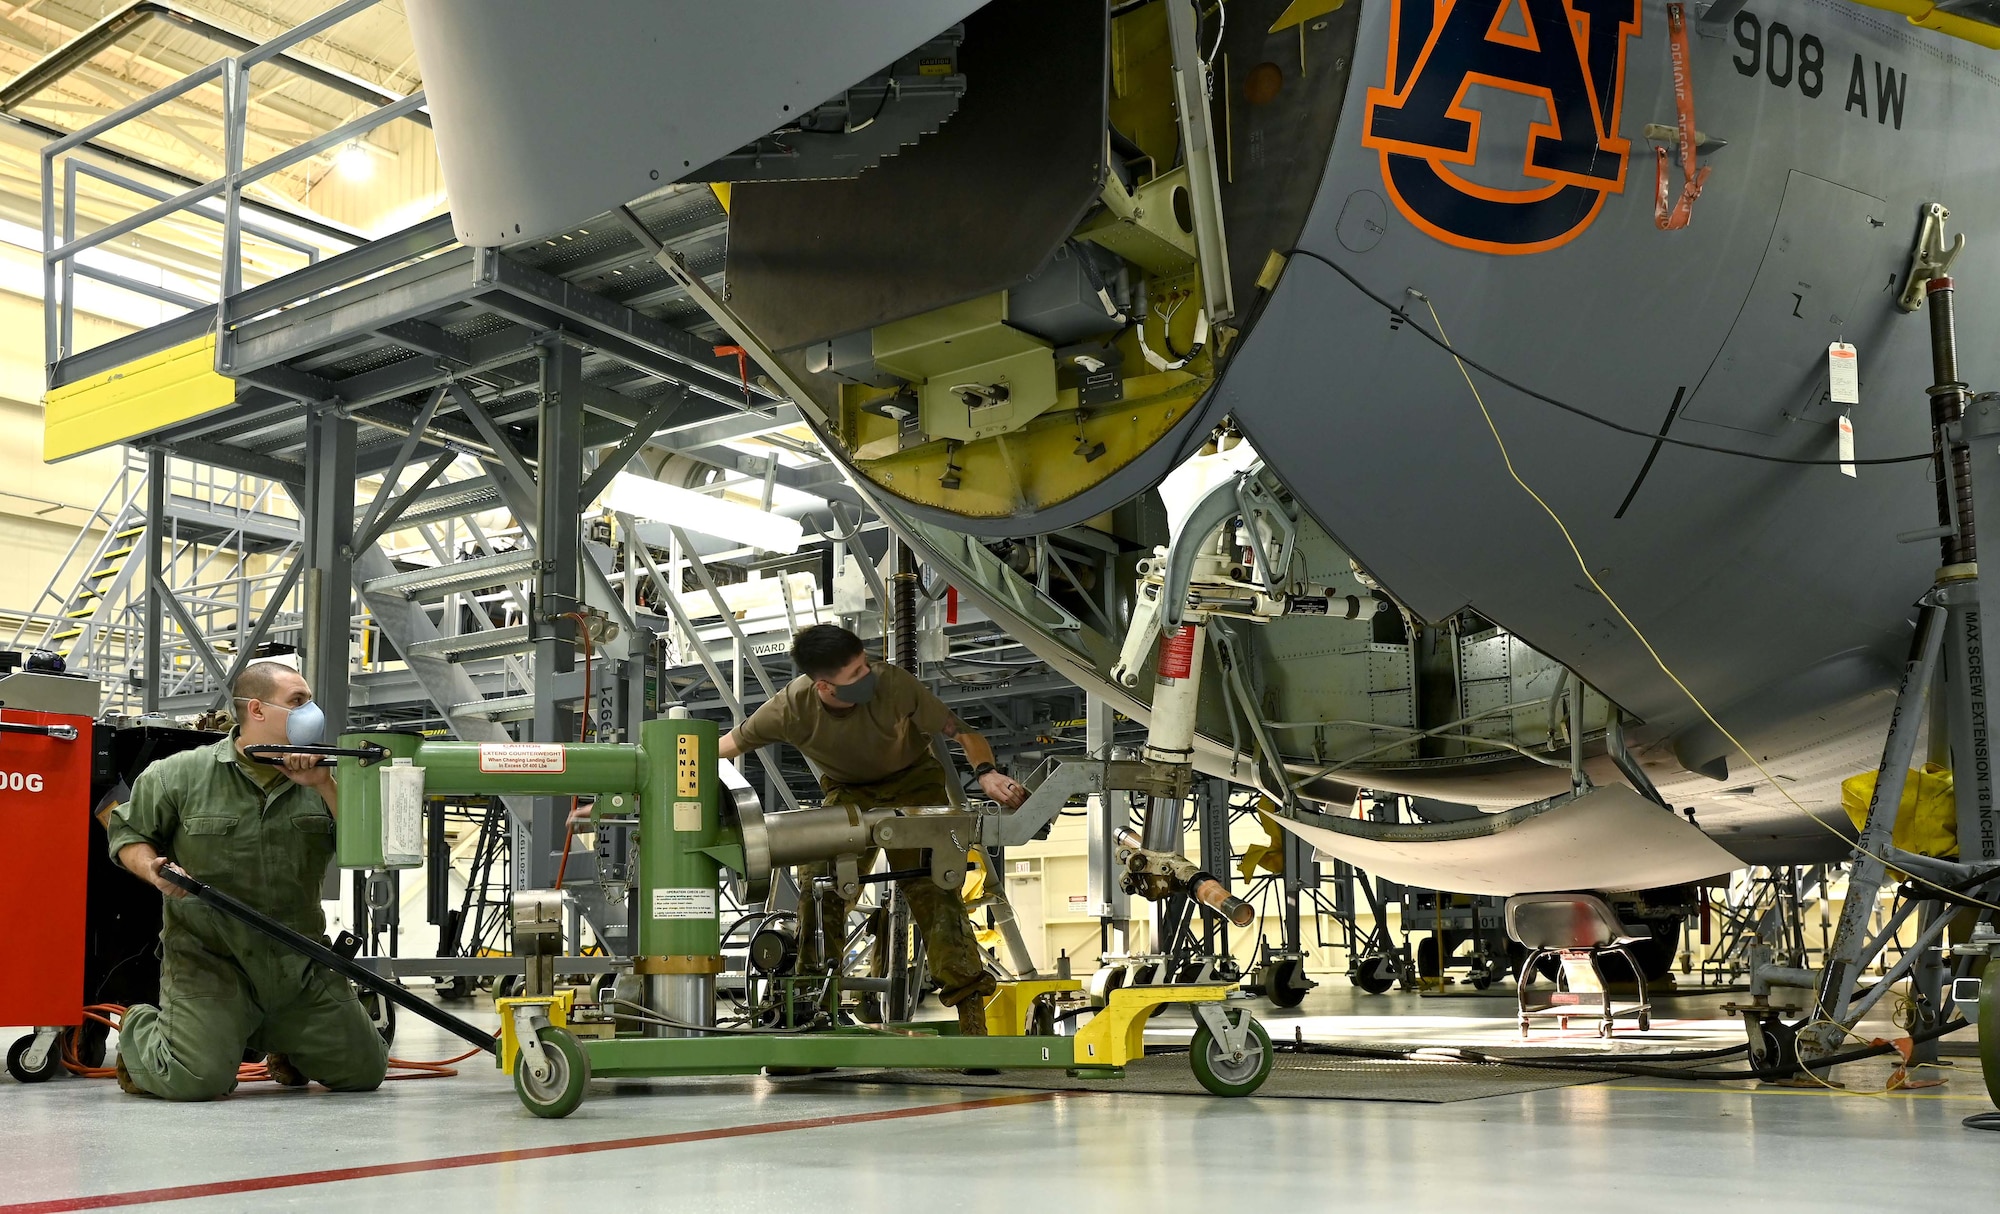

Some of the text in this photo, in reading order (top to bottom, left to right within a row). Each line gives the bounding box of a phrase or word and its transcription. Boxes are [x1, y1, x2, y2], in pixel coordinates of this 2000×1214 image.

[1732, 9, 1907, 131] 908 AW
[1899, 663, 1913, 695] MAX
[1887, 706, 1901, 738] CAP
[1965, 612, 1995, 859] MAX SCREW EXTENSION 18 INCHES
[679, 737, 687, 777] OMNI
[689, 759, 697, 789] ARM
[1016, 862, 1029, 873] EXIT
[1481, 917, 1495, 928] 01
